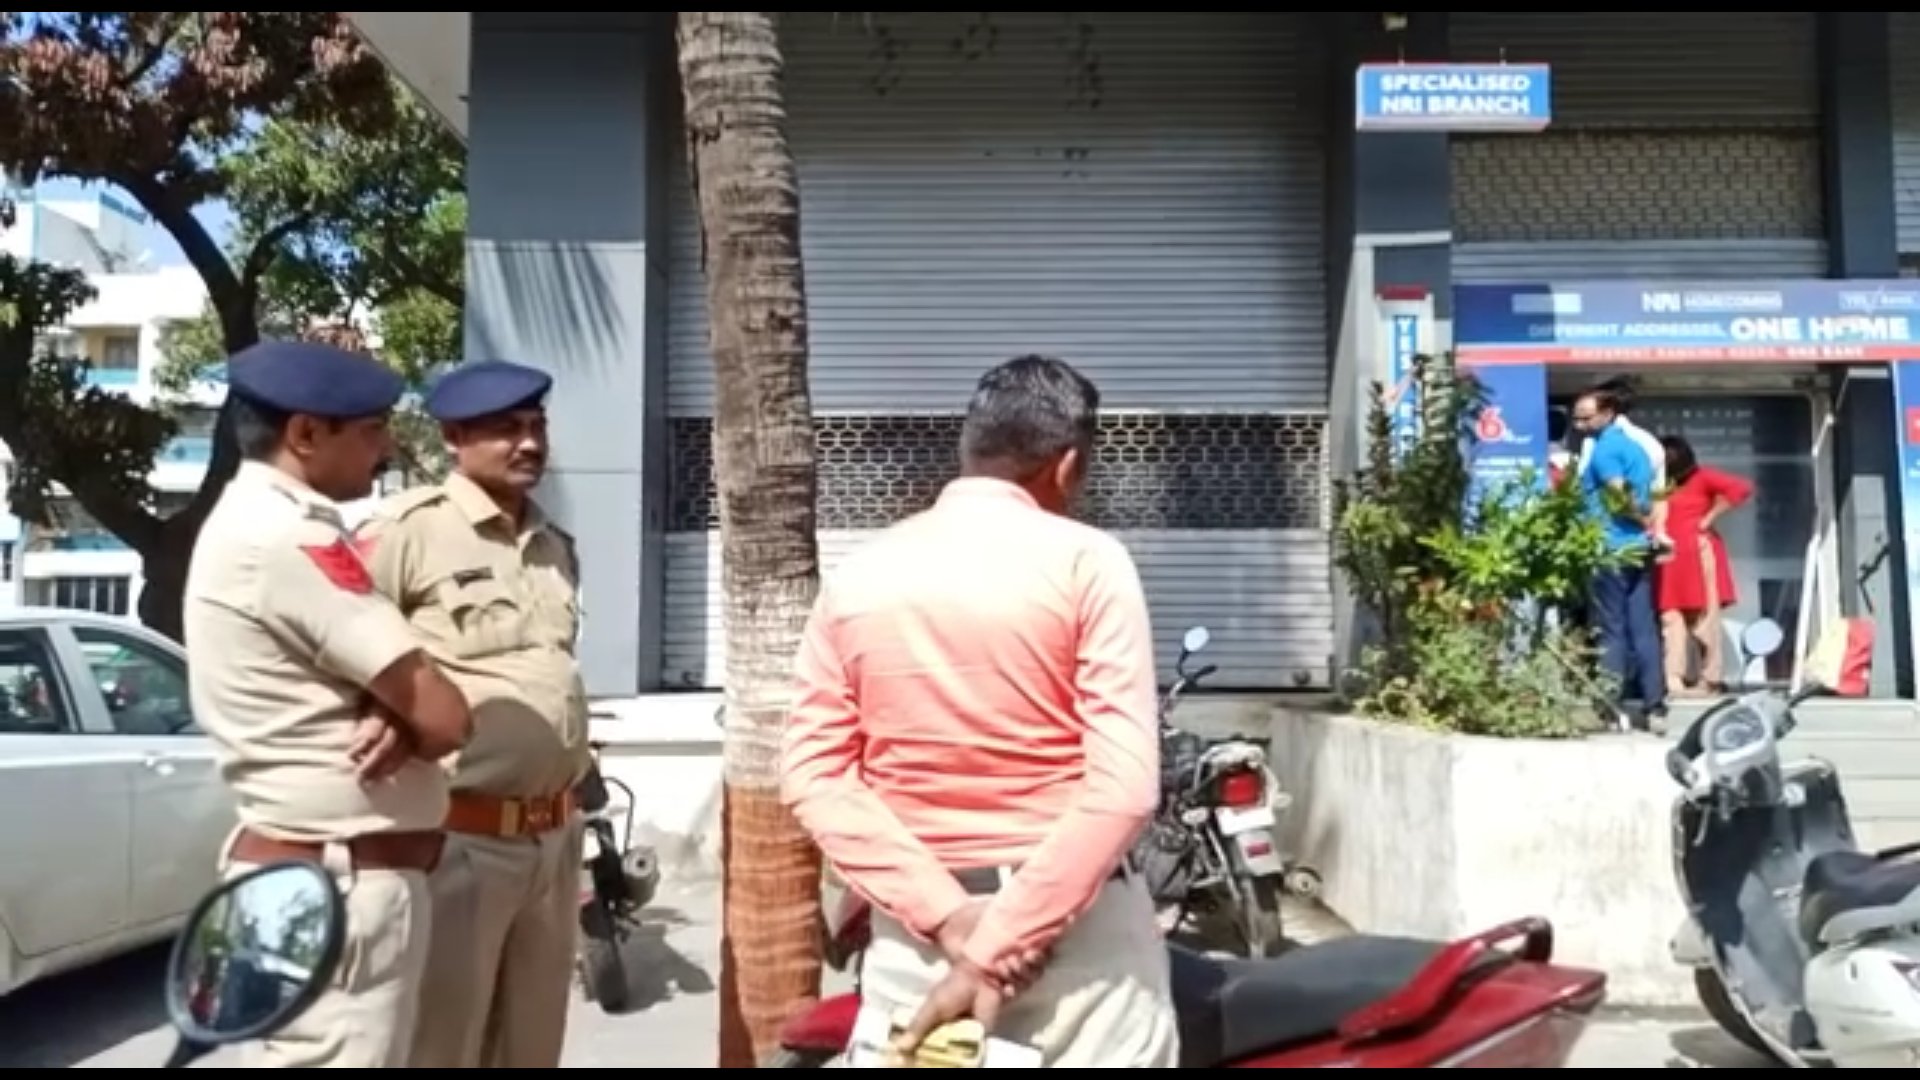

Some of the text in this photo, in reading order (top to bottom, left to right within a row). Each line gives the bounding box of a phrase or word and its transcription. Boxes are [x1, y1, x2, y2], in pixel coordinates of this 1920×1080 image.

[1380, 73, 1532, 92] SPECIALISED
[1380, 95, 1532, 115] NRI BRANCH
[1641, 291, 1682, 313] NRI
[1729, 316, 1802, 342] ONE
[1807, 316, 1912, 342] HOME
